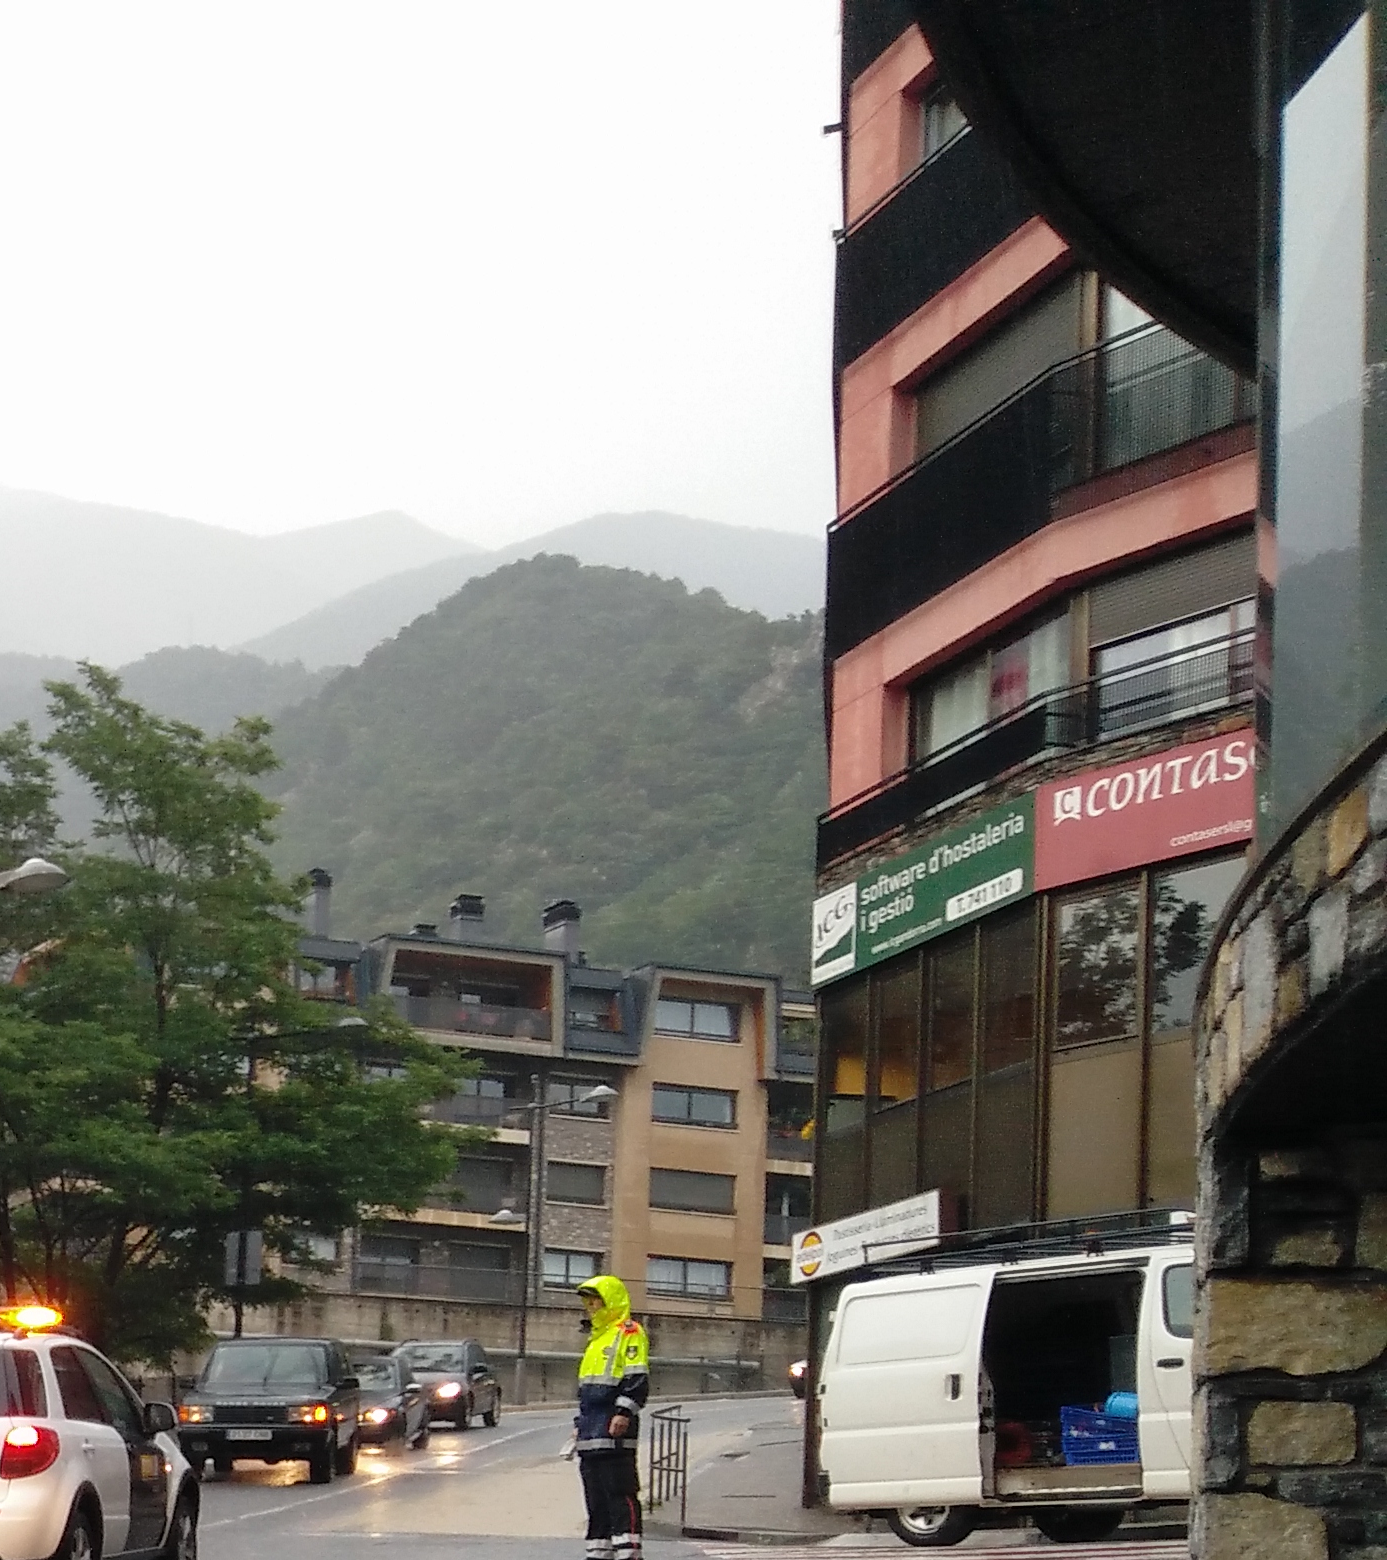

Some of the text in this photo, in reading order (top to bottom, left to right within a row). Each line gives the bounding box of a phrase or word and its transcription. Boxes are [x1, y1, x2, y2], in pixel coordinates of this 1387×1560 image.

[1086, 741, 1255, 817] CONTAS
[860, 813, 1024, 905] software d'hostaleria
[860, 887, 914, 933] i gestió
